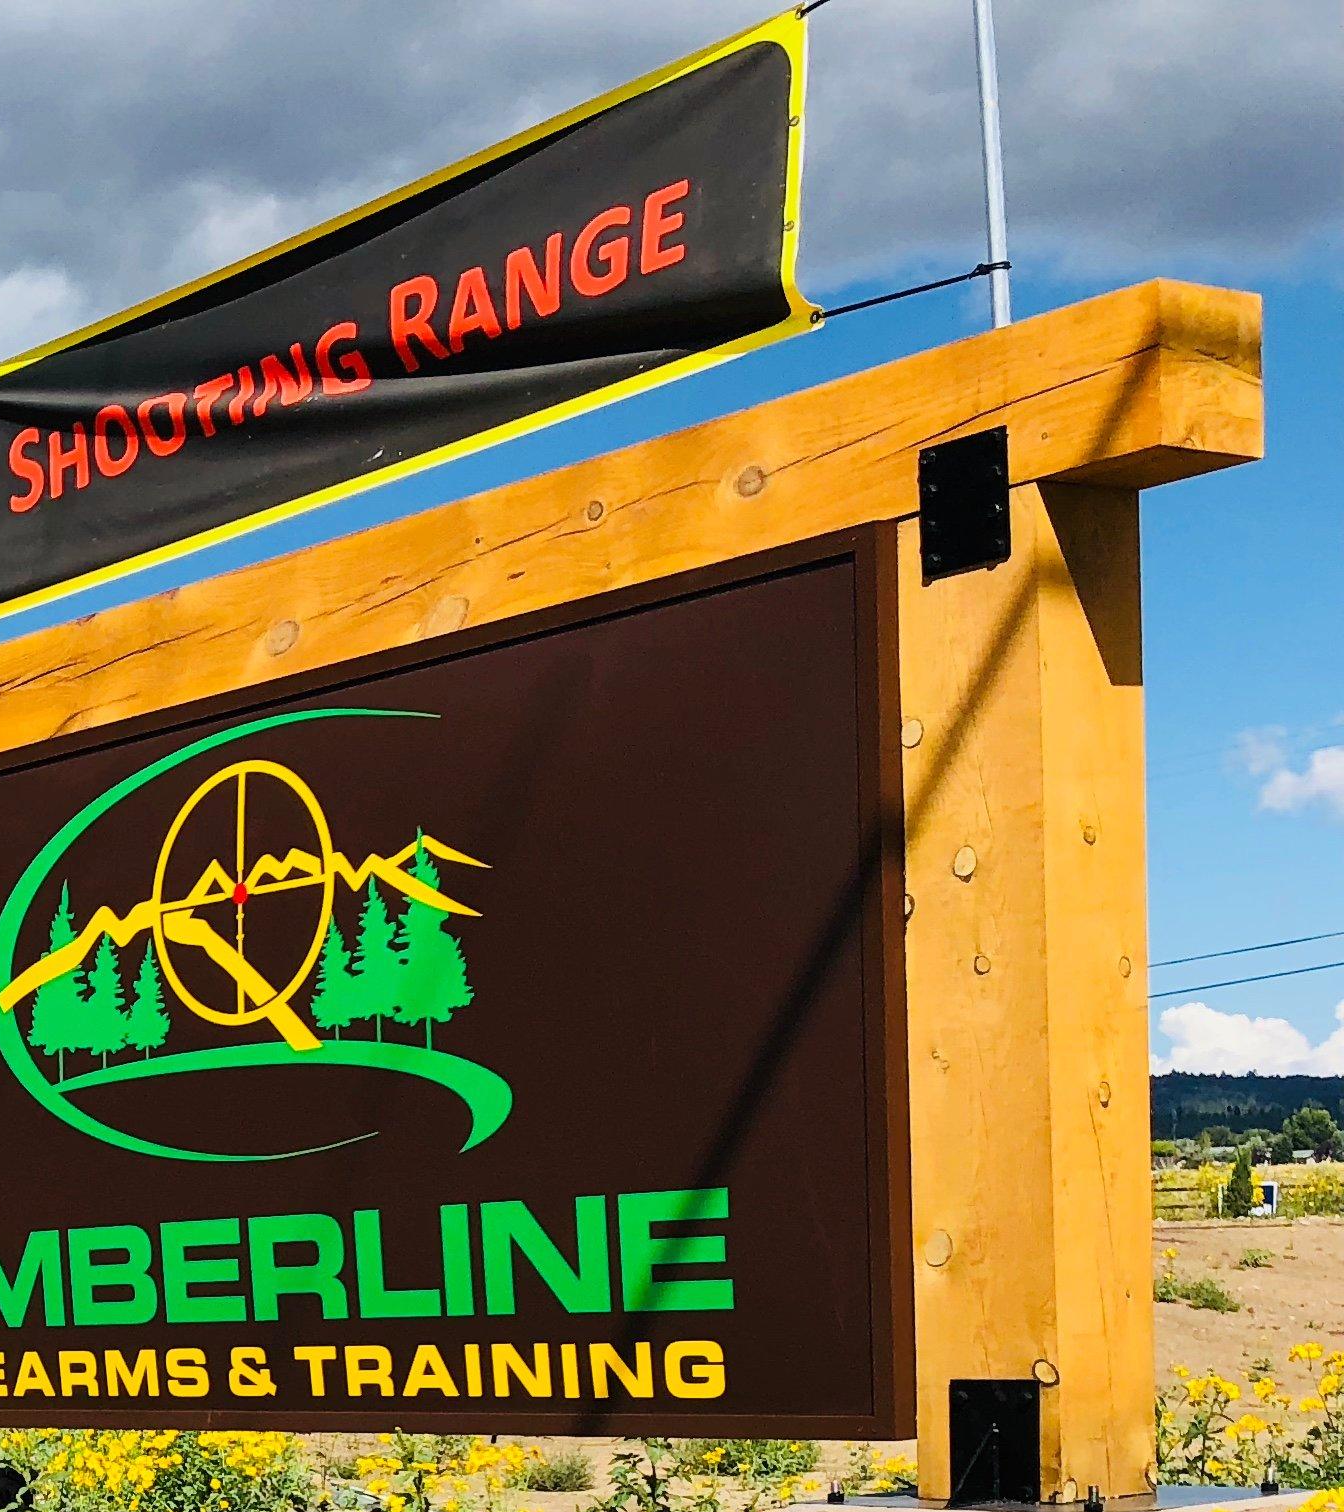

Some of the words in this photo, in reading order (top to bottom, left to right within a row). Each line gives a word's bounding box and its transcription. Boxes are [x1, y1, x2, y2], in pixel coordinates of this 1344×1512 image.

[8, 321, 374, 513] SHOOTING
[389, 178, 690, 373] RANGE
[228, 1346, 277, 1397] &
[293, 1340, 726, 1399] TRAINING
